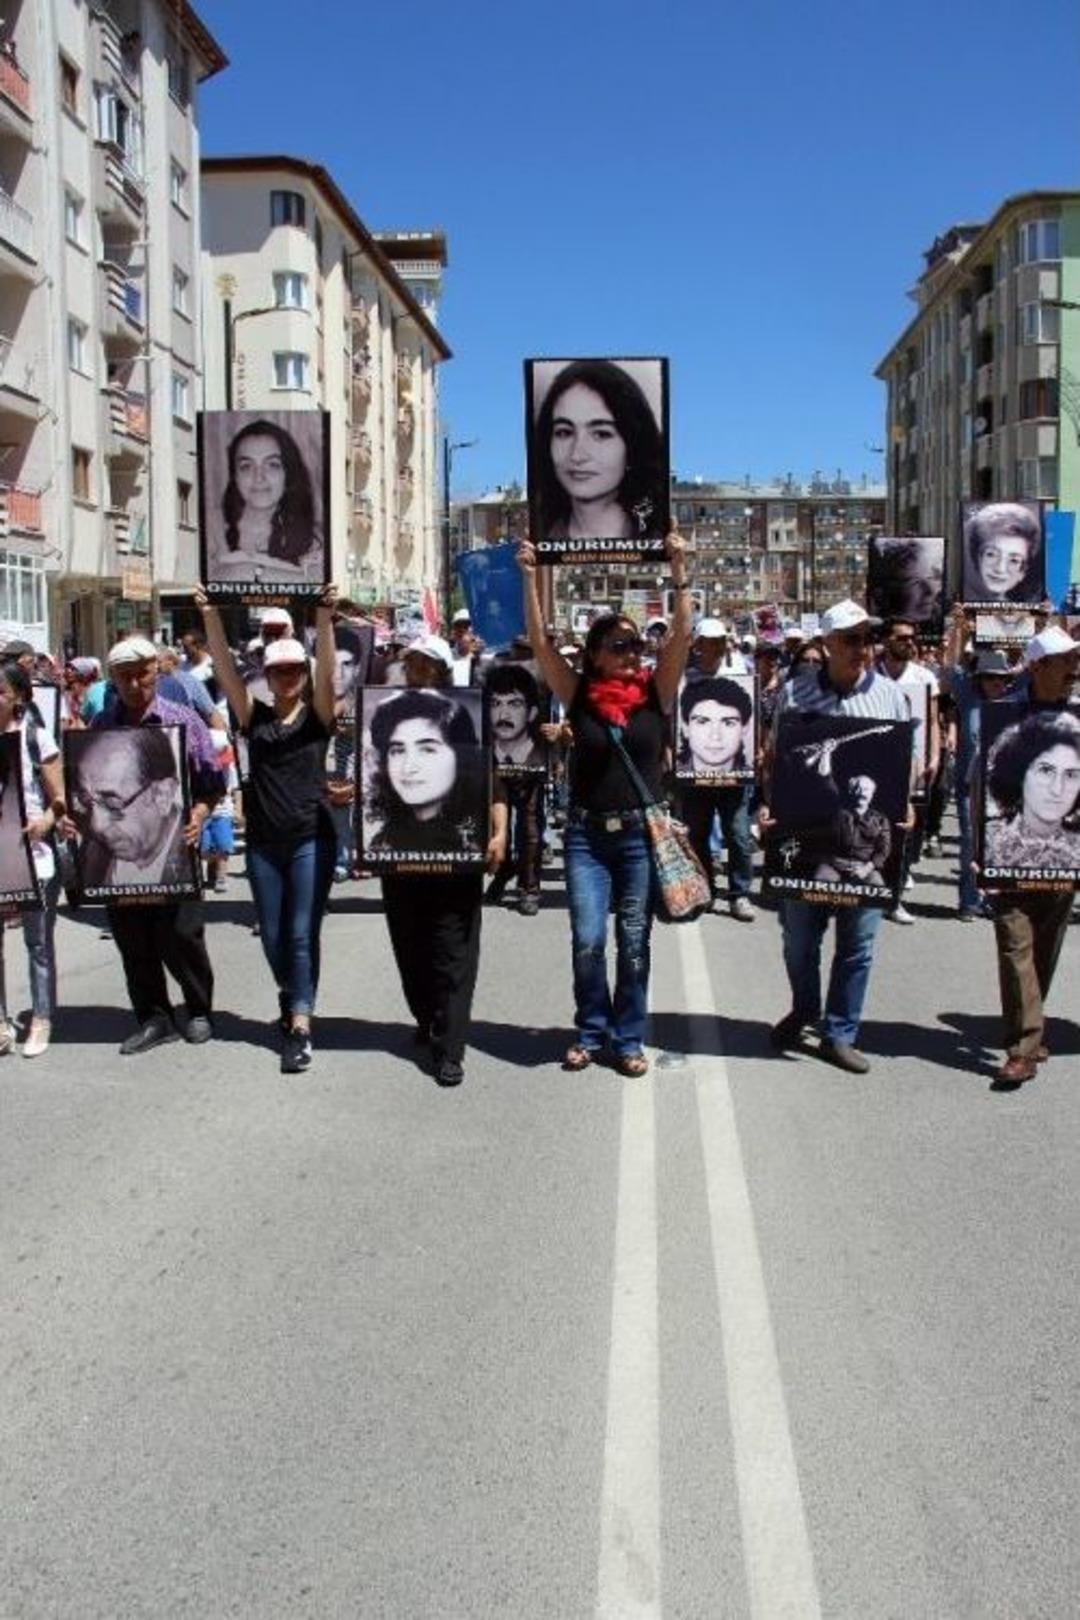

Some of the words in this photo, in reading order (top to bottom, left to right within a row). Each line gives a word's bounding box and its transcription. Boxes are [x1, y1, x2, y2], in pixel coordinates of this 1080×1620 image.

[537, 540, 664, 552] ONURUMUZ
[207, 582, 324, 595] ONURUMUZ
[363, 850, 483, 861] ONURUMUZ
[983, 867, 1080, 880] ONURUM
[84, 882, 196, 897] ONURUMUZ
[768, 876, 893, 898] ONURUMUZ
